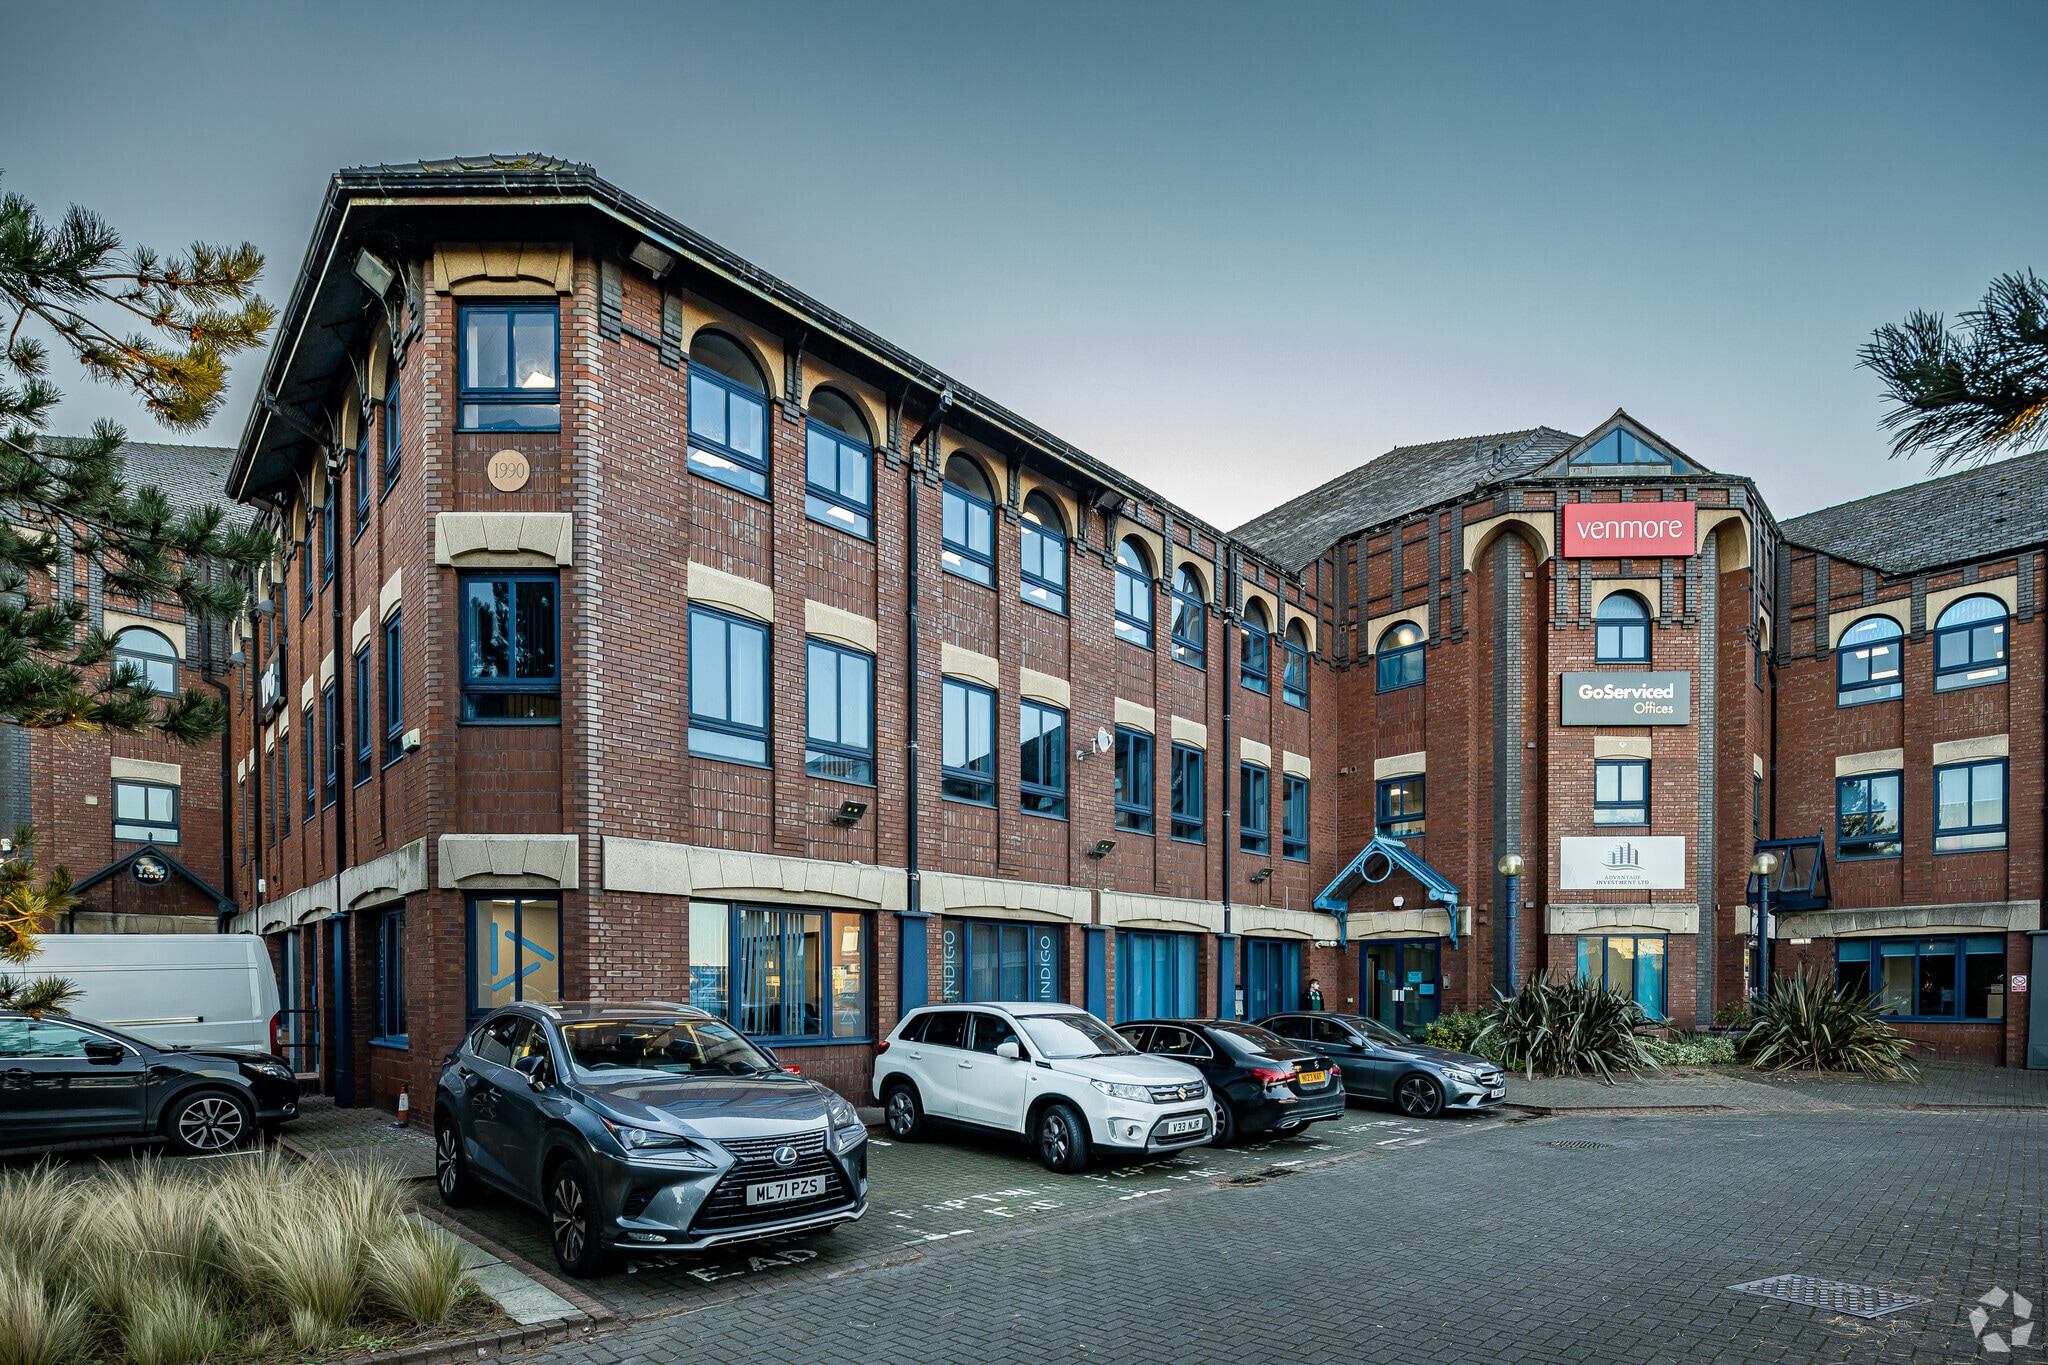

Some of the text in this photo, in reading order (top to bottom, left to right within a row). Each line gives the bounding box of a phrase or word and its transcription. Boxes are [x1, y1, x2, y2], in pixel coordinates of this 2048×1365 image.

[495, 462, 525, 478] 1990
[1576, 519, 1683, 539] venmore
[1578, 682, 1674, 699] GoServiced
[1633, 701, 1674, 714] Offices
[943, 930, 955, 999] INDIGO
[1040, 935, 1051, 998] INDIGO
[1173, 1120, 1200, 1132] V33 NJR
[756, 1179, 818, 1202] ML71 PZS
